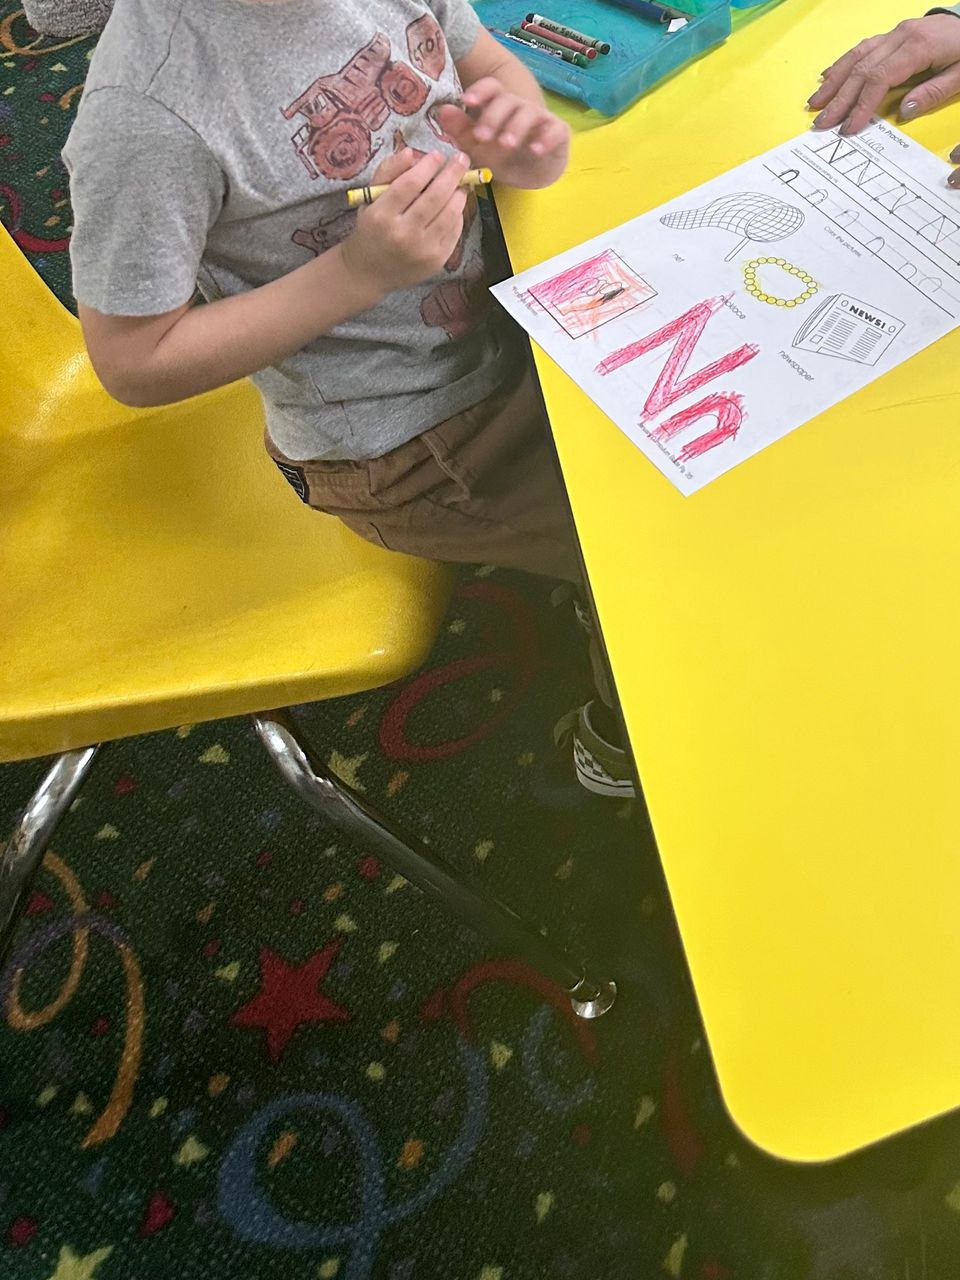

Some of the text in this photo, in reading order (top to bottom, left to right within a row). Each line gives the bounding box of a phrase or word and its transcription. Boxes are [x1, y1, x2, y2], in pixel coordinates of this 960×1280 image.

[885, 129, 909, 149] Practice
[673, 253, 686, 263] net
[778, 350, 815, 382] newspaper
